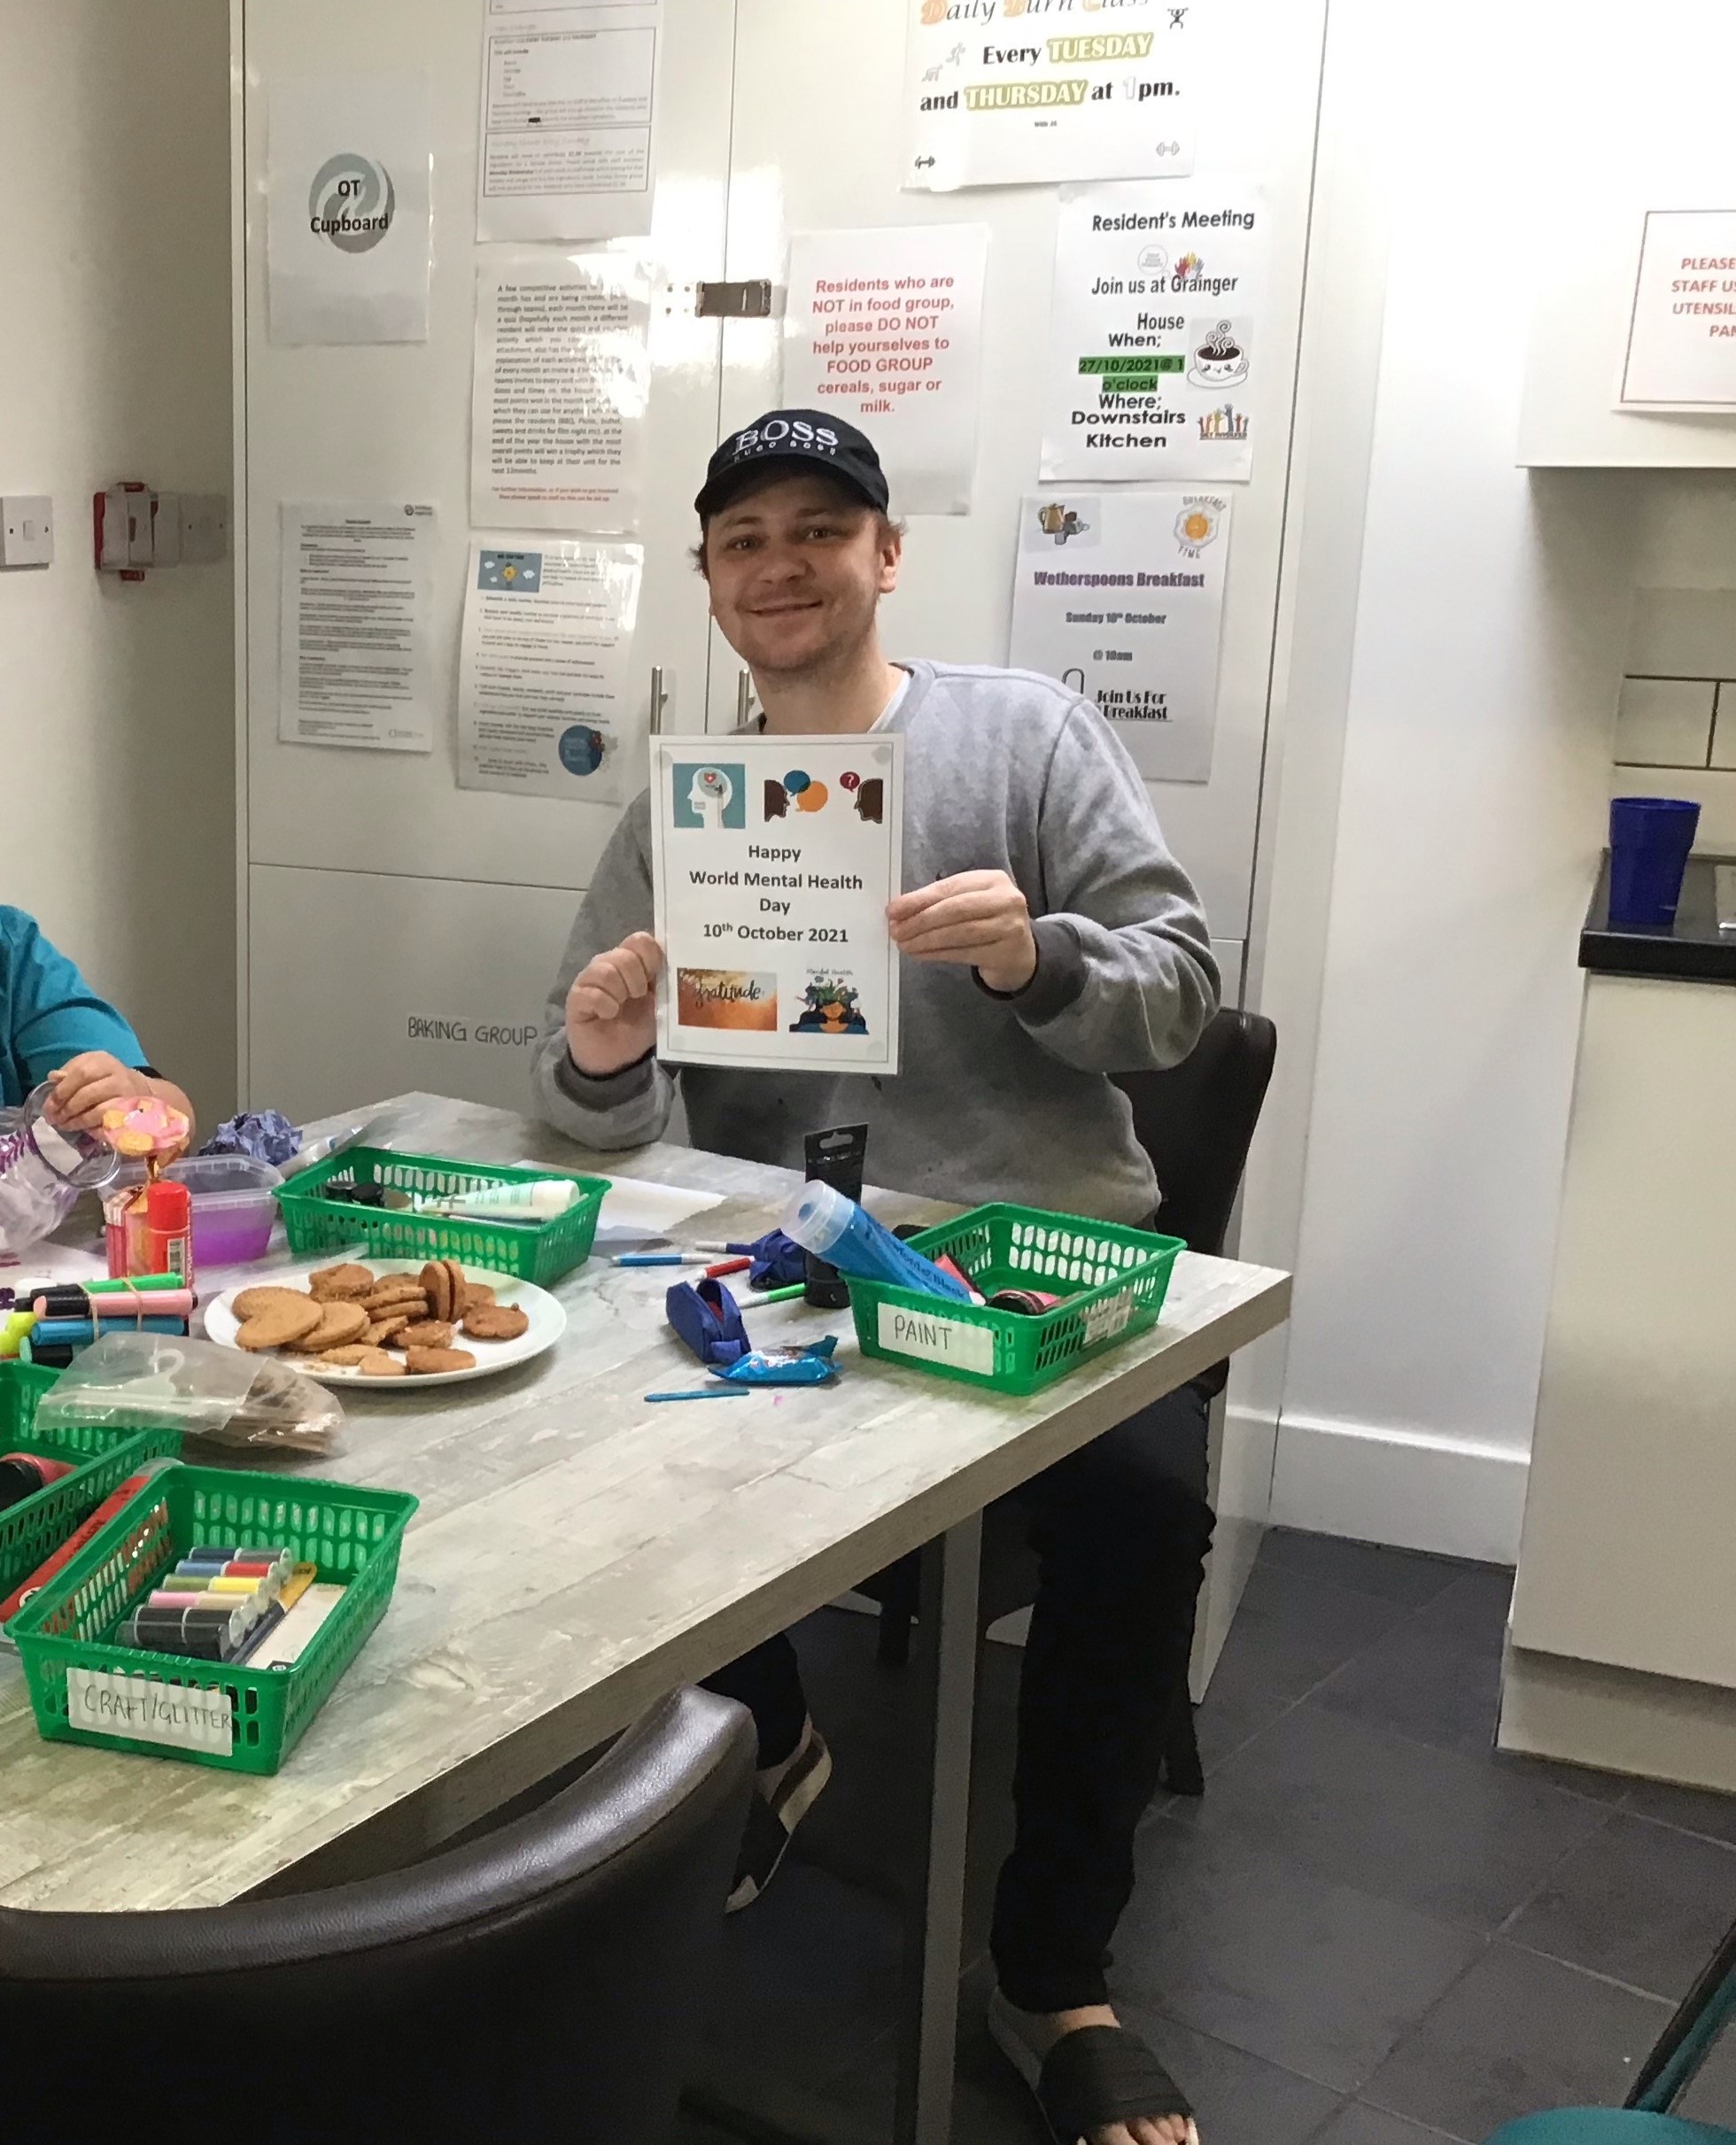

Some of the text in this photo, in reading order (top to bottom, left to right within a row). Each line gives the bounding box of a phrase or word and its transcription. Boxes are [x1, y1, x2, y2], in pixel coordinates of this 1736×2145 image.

[983, 33, 1153, 66] Every TUESDAY
[919, 77, 1180, 112] and THURSDAY at 1pm.
[337, 180, 360, 197] OT
[310, 213, 389, 236] Cupboard
[1092, 209, 1255, 231] Resident's Meeting
[1681, 257, 1736, 270] PLEASE
[816, 276, 954, 293] Residents who are
[1091, 275, 1238, 296] Join us at Grainger
[1670, 280, 1718, 292] STAFF
[812, 298, 954, 314] NOT in food group,
[825, 316, 939, 336] please DO NOT
[1137, 313, 1184, 330] House
[813, 337, 949, 355] help yourselves to
[827, 357, 933, 374] FOOD GROUP
[818, 380, 942, 394] cereals, sugar or
[1103, 377, 1158, 391] o'clock
[860, 399, 895, 413] milk.
[1098, 393, 1162, 409] Where;
[1071, 409, 1186, 425] Downstairs
[732, 420, 839, 455] BOSS
[1086, 433, 1167, 448] Kitchen
[1035, 571, 1205, 588] Wetherspoons Breakfast
[1066, 612, 1104, 624] Sunday
[1125, 612, 1166, 624] October
[1097, 689, 1123, 703] Join
[748, 845, 801, 863] Happy
[689, 871, 863, 889] World Mental Health
[760, 898, 790, 916] Day
[703, 923, 849, 943] 10th October 2021
[407, 1017, 538, 1047] BAKING GROUP
[895, 1314, 954, 1351] PAINT
[84, 1684, 233, 1730] CRAFT/GLITTER
